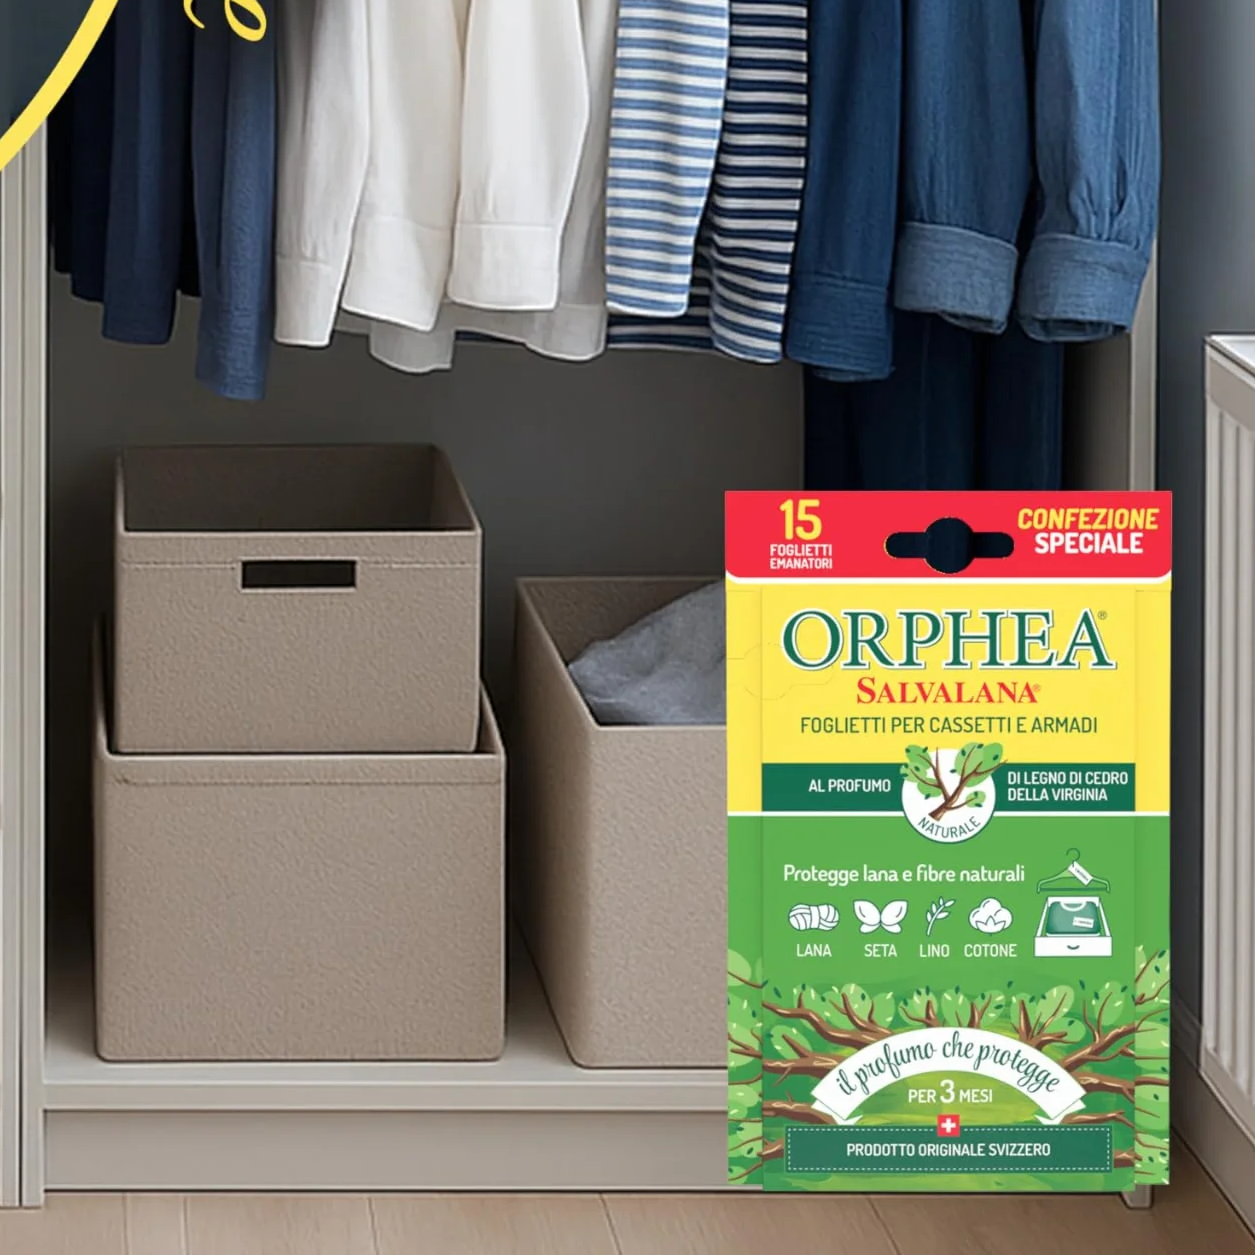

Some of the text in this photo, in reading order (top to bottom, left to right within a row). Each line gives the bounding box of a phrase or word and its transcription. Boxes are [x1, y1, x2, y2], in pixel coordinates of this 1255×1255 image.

[779, 498, 822, 541] 15
[1017, 507, 1160, 531] CONFEZIONE
[769, 543, 833, 557] FOGLIETTI
[1034, 532, 1144, 555] SPECIALE
[769, 557, 833, 570] EMANATORI
[800, 716, 1098, 734] FOGLIETTI PER CASSETTI E ARMADI
[808, 779, 891, 793] AL PROFUMO
[1007, 771, 1129, 786] DI LEGNO DI CEDRO
[1007, 788, 1108, 802] DELLA VIRGINIA
[918, 816, 981, 839] NATURALE
[783, 864, 1025, 887] Protegge lana e fibre naturali
[796, 943, 832, 958] LANA
[863, 943, 897, 958] SETA
[919, 943, 950, 958] LINO
[963, 943, 1018, 958] COTONE
[836, 1030, 1060, 1095] il profumo che protegge
[908, 1079, 993, 1104] PER 3 MESI
[846, 1143, 1051, 1157] PRODOTTO ORIGINALE SVIZZERO
